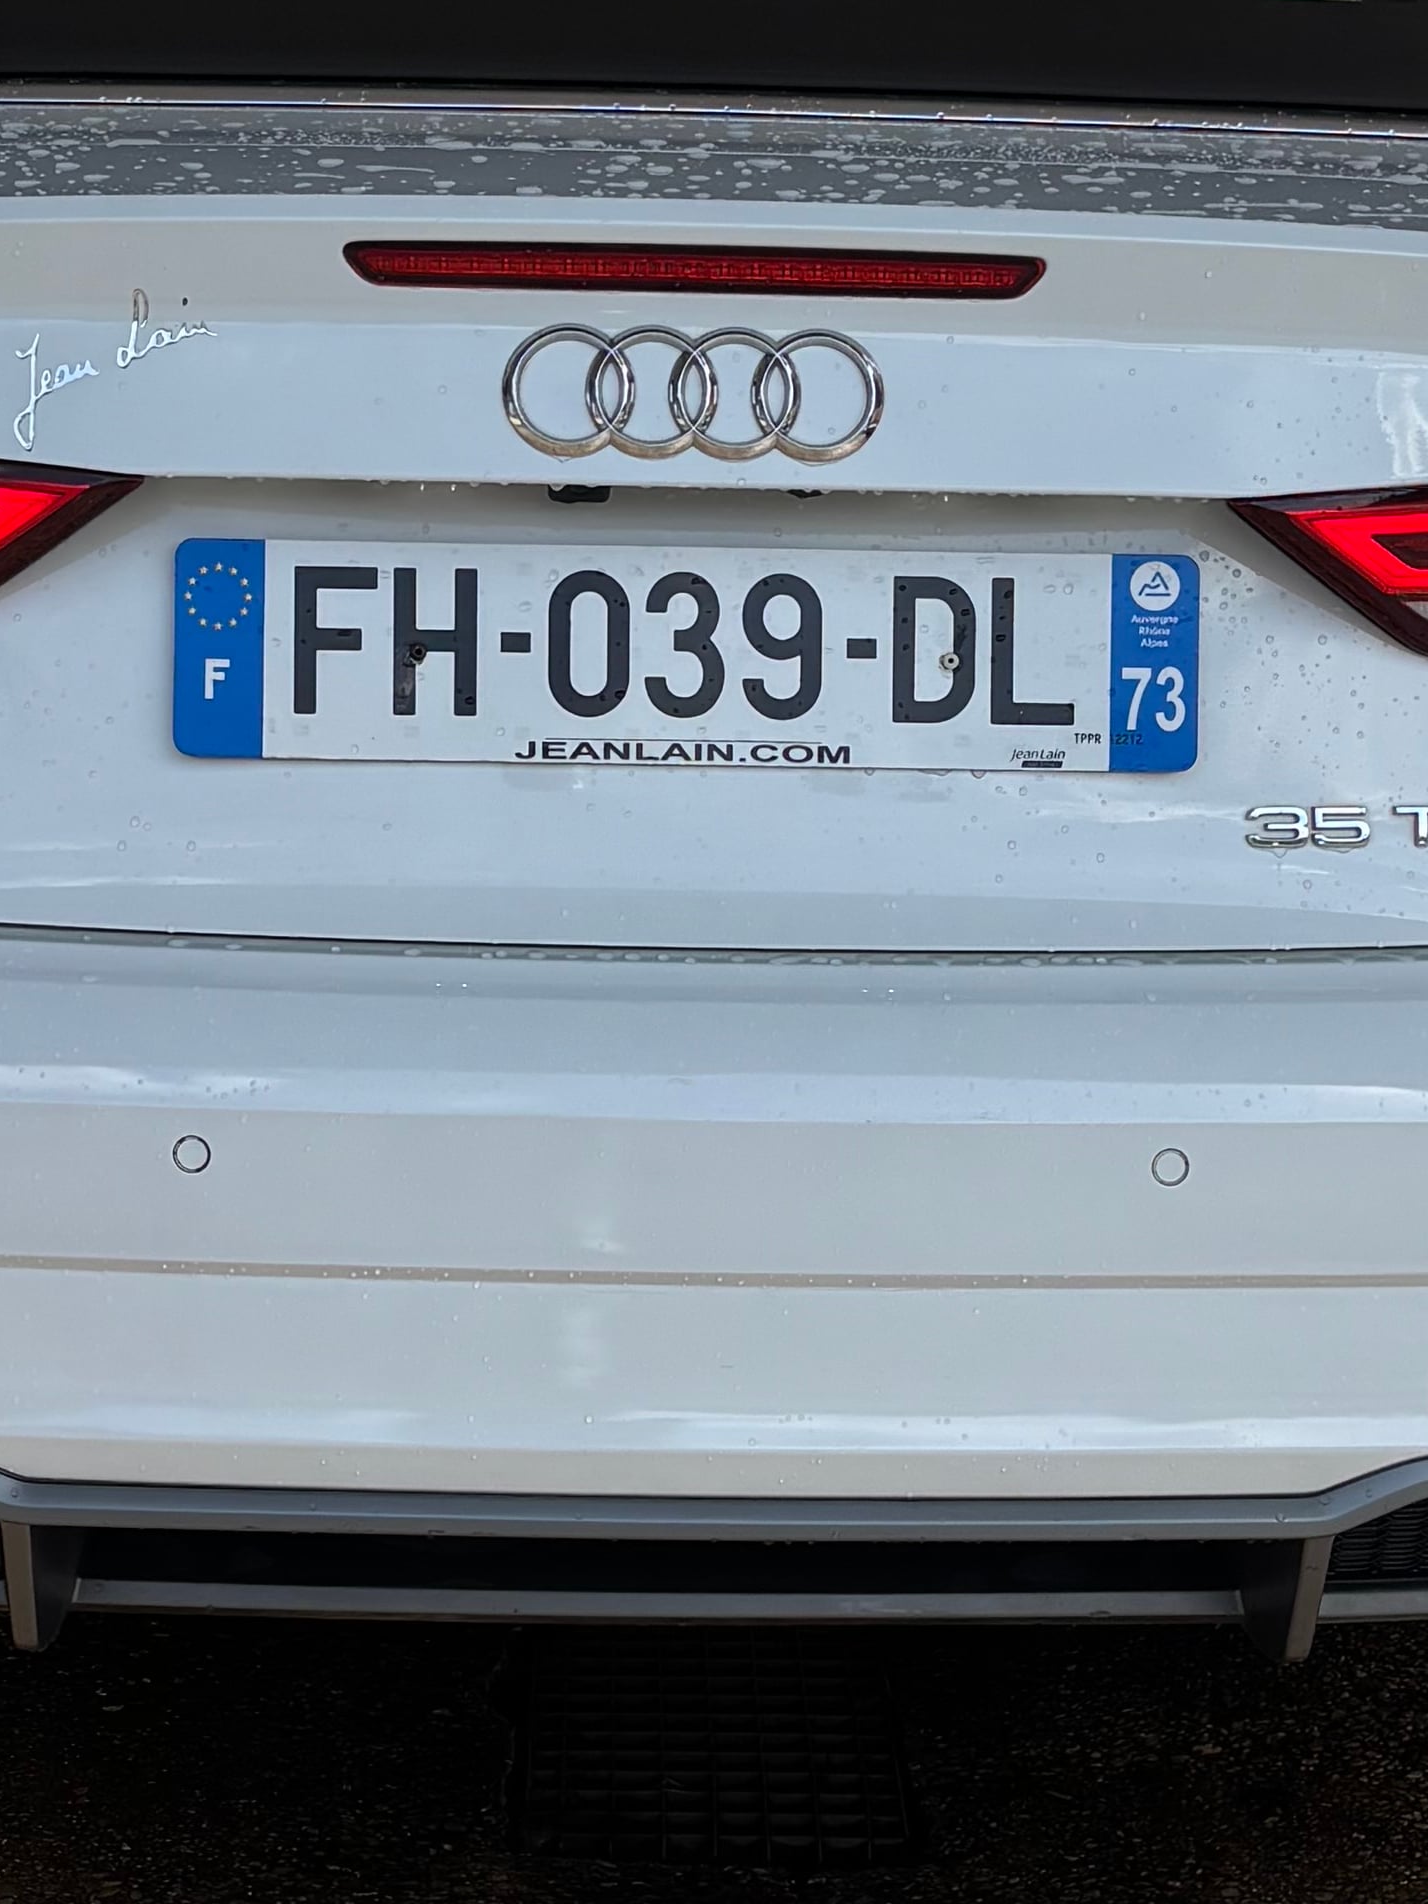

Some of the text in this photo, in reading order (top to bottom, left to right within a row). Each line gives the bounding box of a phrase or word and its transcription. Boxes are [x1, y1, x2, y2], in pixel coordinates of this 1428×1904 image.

[293, 565, 1076, 726] FH-039-DL
[203, 658, 231, 700] F
[1121, 666, 1187, 732] 73
[514, 740, 851, 764] JEANLAIN.COM
[1244, 804, 1371, 849] 35
